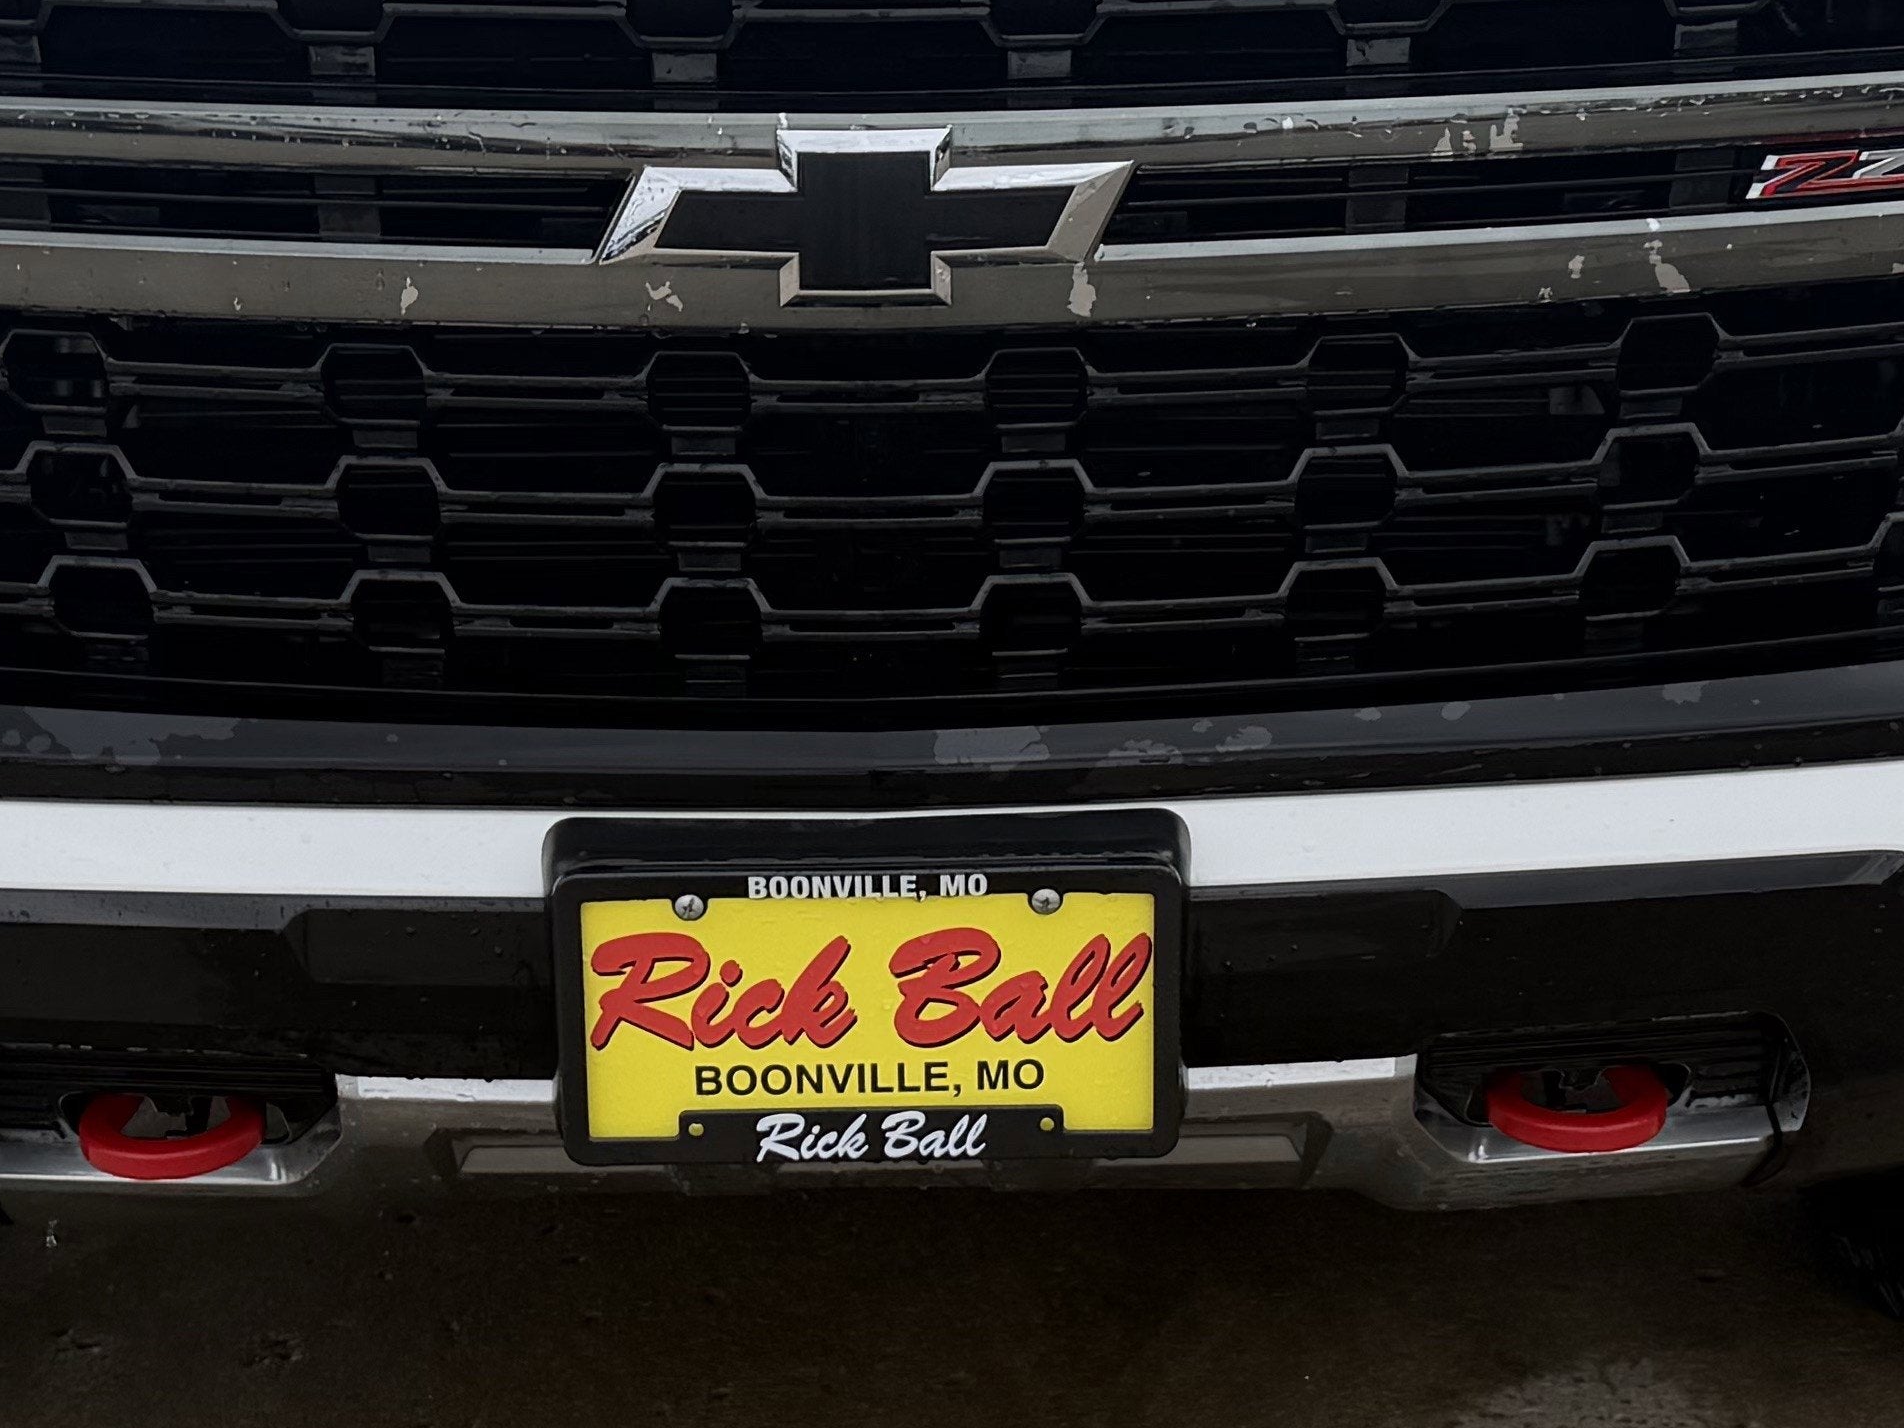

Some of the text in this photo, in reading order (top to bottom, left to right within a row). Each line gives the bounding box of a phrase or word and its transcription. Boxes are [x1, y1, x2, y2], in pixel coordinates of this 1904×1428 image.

[747, 873, 988, 901] BOONVILLE, MO
[590, 926, 1154, 1051] Rick Ball
[695, 1058, 1045, 1098] BOONVILLE, MO
[755, 1112, 988, 1162] Rick Ball
